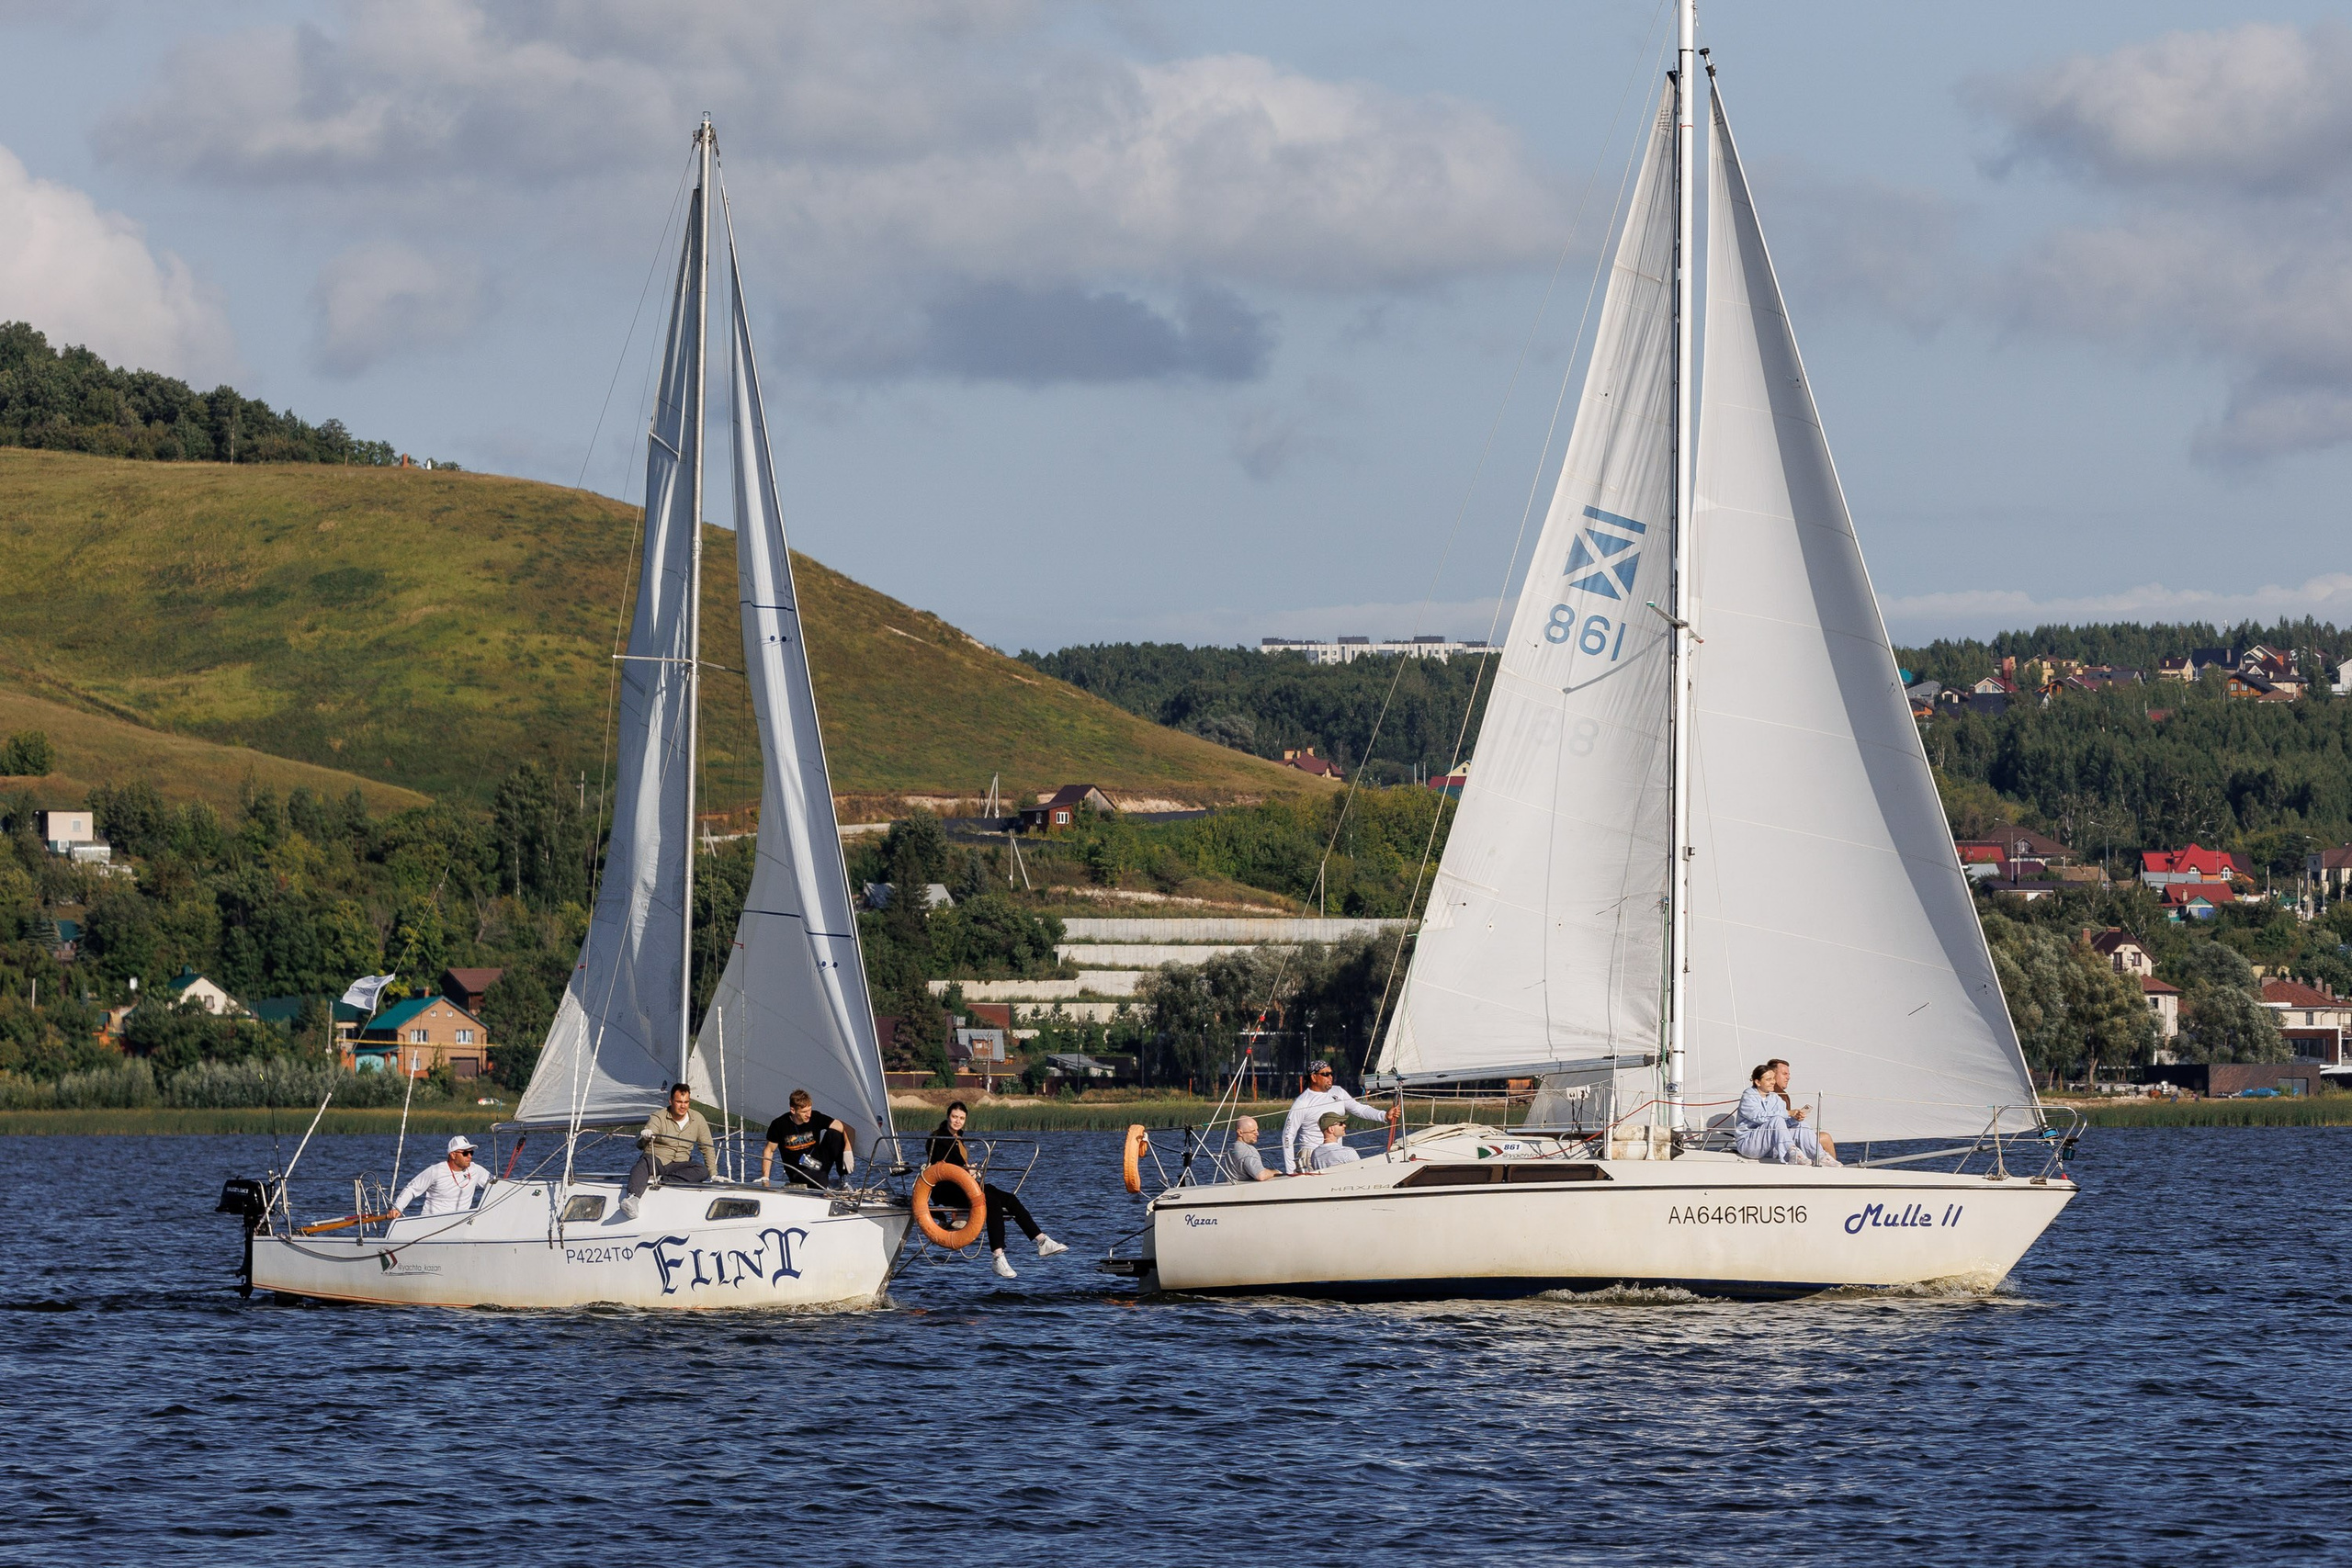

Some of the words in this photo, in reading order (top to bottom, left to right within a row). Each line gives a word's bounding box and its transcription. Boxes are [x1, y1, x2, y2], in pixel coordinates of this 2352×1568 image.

[1544, 604, 1626, 662] 861
[226, 1186, 249, 1194] SUZUKI
[1184, 1213, 1218, 1227] Kazan
[1668, 1205, 1808, 1224] AA6461RUS16
[1844, 1202, 1934, 1235] Mulle
